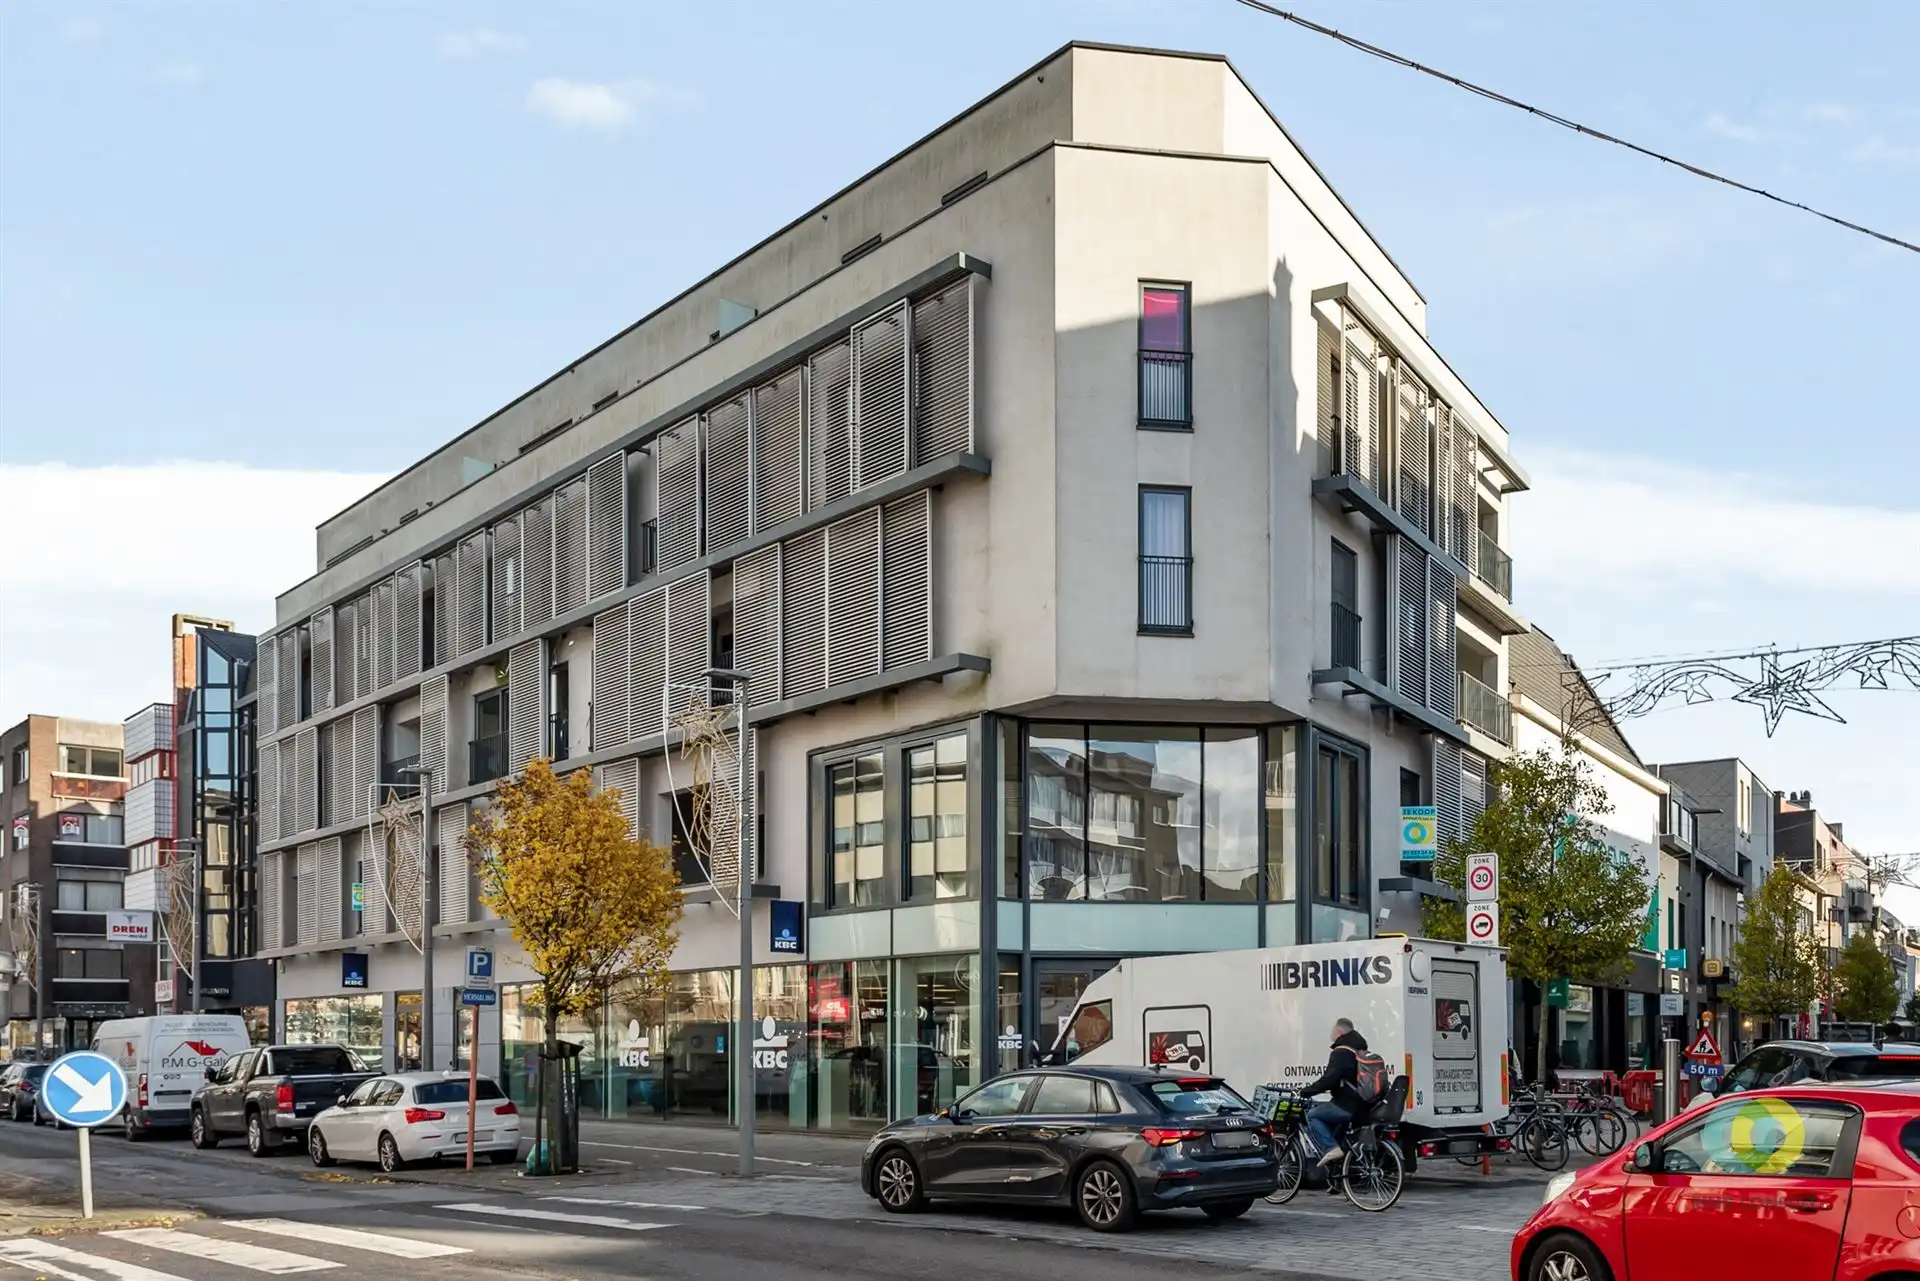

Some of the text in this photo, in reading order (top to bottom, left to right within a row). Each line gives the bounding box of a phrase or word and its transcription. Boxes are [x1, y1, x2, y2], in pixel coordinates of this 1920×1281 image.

[1413, 808, 1435, 816] KOOP
[1475, 873, 1488, 882] 30
[112, 925, 148, 933] DRENI
[774, 941, 797, 949] KBC
[473, 953, 488, 974] P
[1281, 955, 1393, 989] BRINKS
[998, 1040, 1022, 1049] KBC
[619, 1051, 650, 1068] KBC
[752, 1050, 787, 1069] KBC
[1690, 1065, 1718, 1075] 50 m
